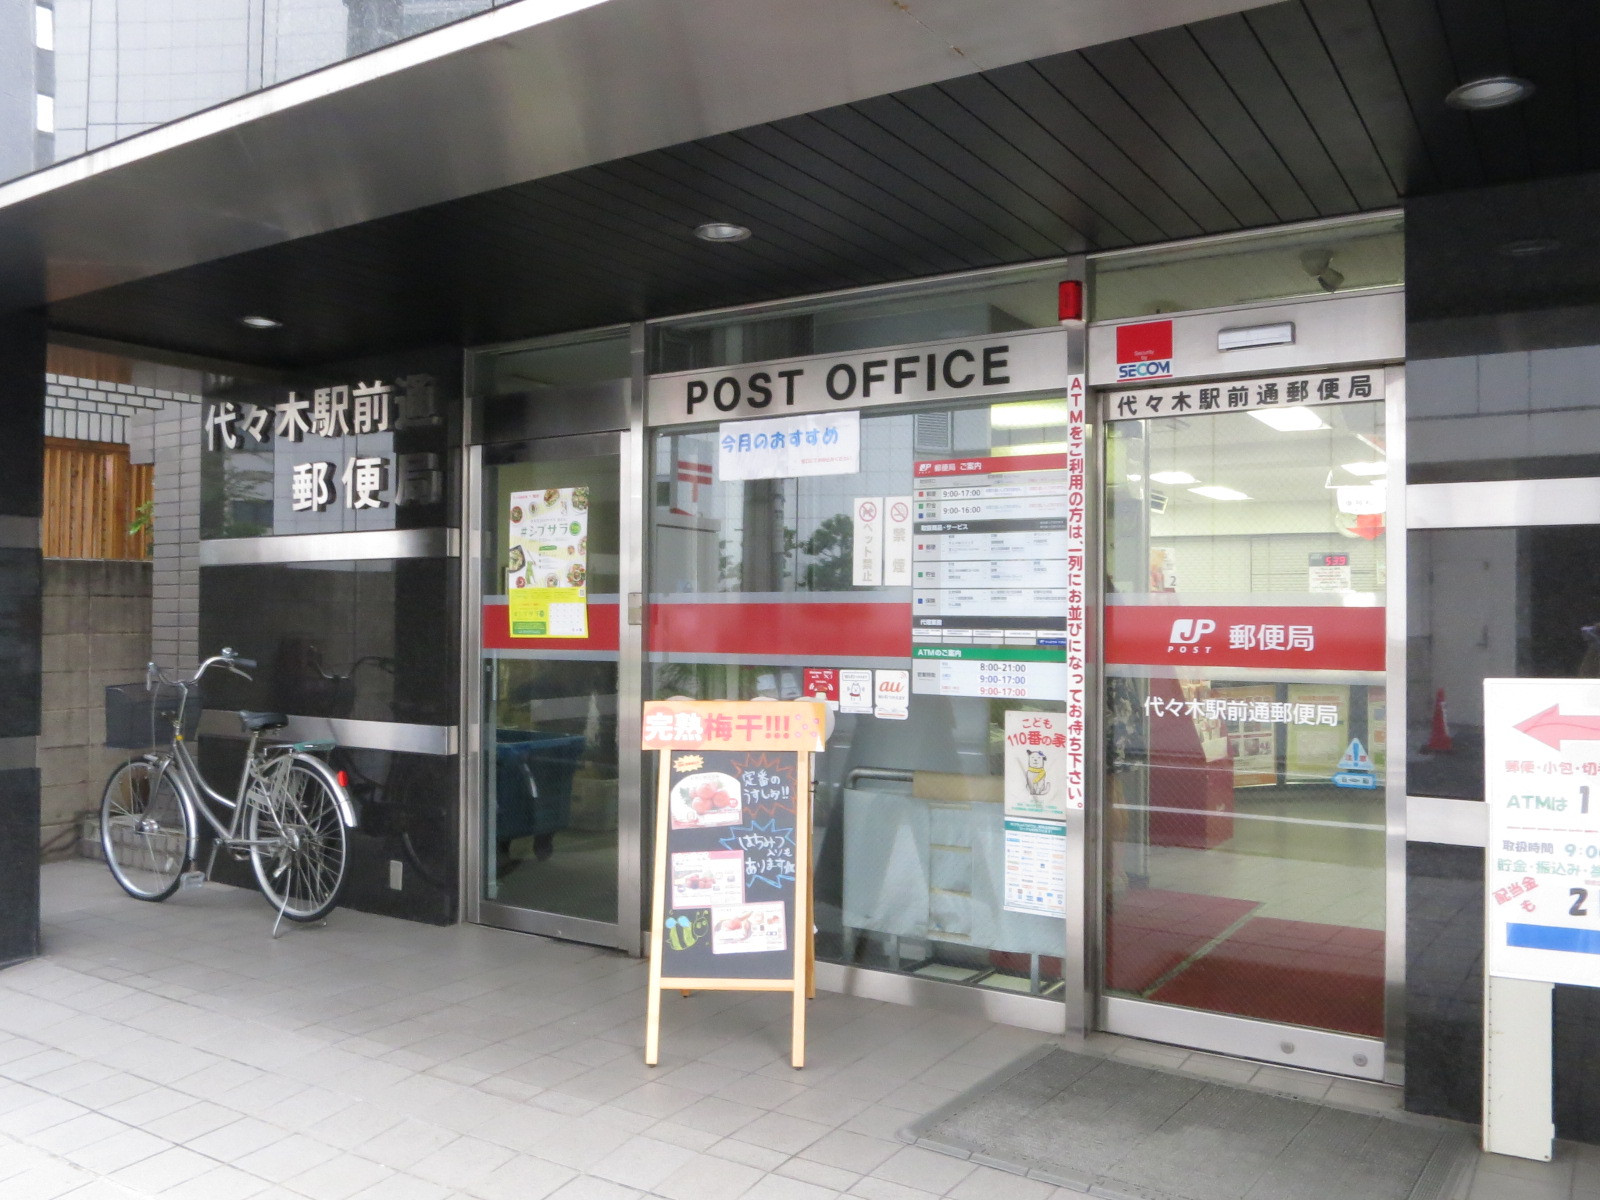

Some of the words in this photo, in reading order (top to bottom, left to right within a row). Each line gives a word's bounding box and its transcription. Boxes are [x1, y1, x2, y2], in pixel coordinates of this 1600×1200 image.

[1118, 361, 1170, 378] SECOM
[686, 369, 803, 415] POST
[826, 345, 1010, 400] OFFICE
[1117, 374, 1372, 417] 代々木駅前通郵便局
[721, 426, 839, 453] 今月のおすすめ
[960, 461, 982, 471] ご案内
[943, 489, 981, 497] 9:00-17:00
[943, 506, 981, 514] 9:00-16:00
[1170, 619, 1216, 644] JP
[1229, 624, 1314, 651] 郵便局
[918, 649, 962, 658] ATMのご案内
[1168, 646, 1212, 654] POST
[980, 663, 1026, 673] 8:00-21:00
[880, 681, 904, 692] au
[980, 675, 1026, 684] 9:00-17:00
[980, 687, 1026, 696] 9:00-17:00
[1144, 696, 1338, 727] 代々木駅前通郵便局
[1022, 718, 1053, 730] こども
[1007, 731, 1067, 748] 110番の家
[1505, 760, 1600, 776] 郵便・小包・切
[742, 769, 781, 786] 定番の
[1506, 794, 1568, 812] ATMは
[739, 833, 785, 850] はちみつ
[1502, 840, 1554, 854] 取扱時間
[1565, 843, 1600, 859] 9:0
[1492, 876, 1539, 905] 配当金
[1521, 900, 1536, 912] も
